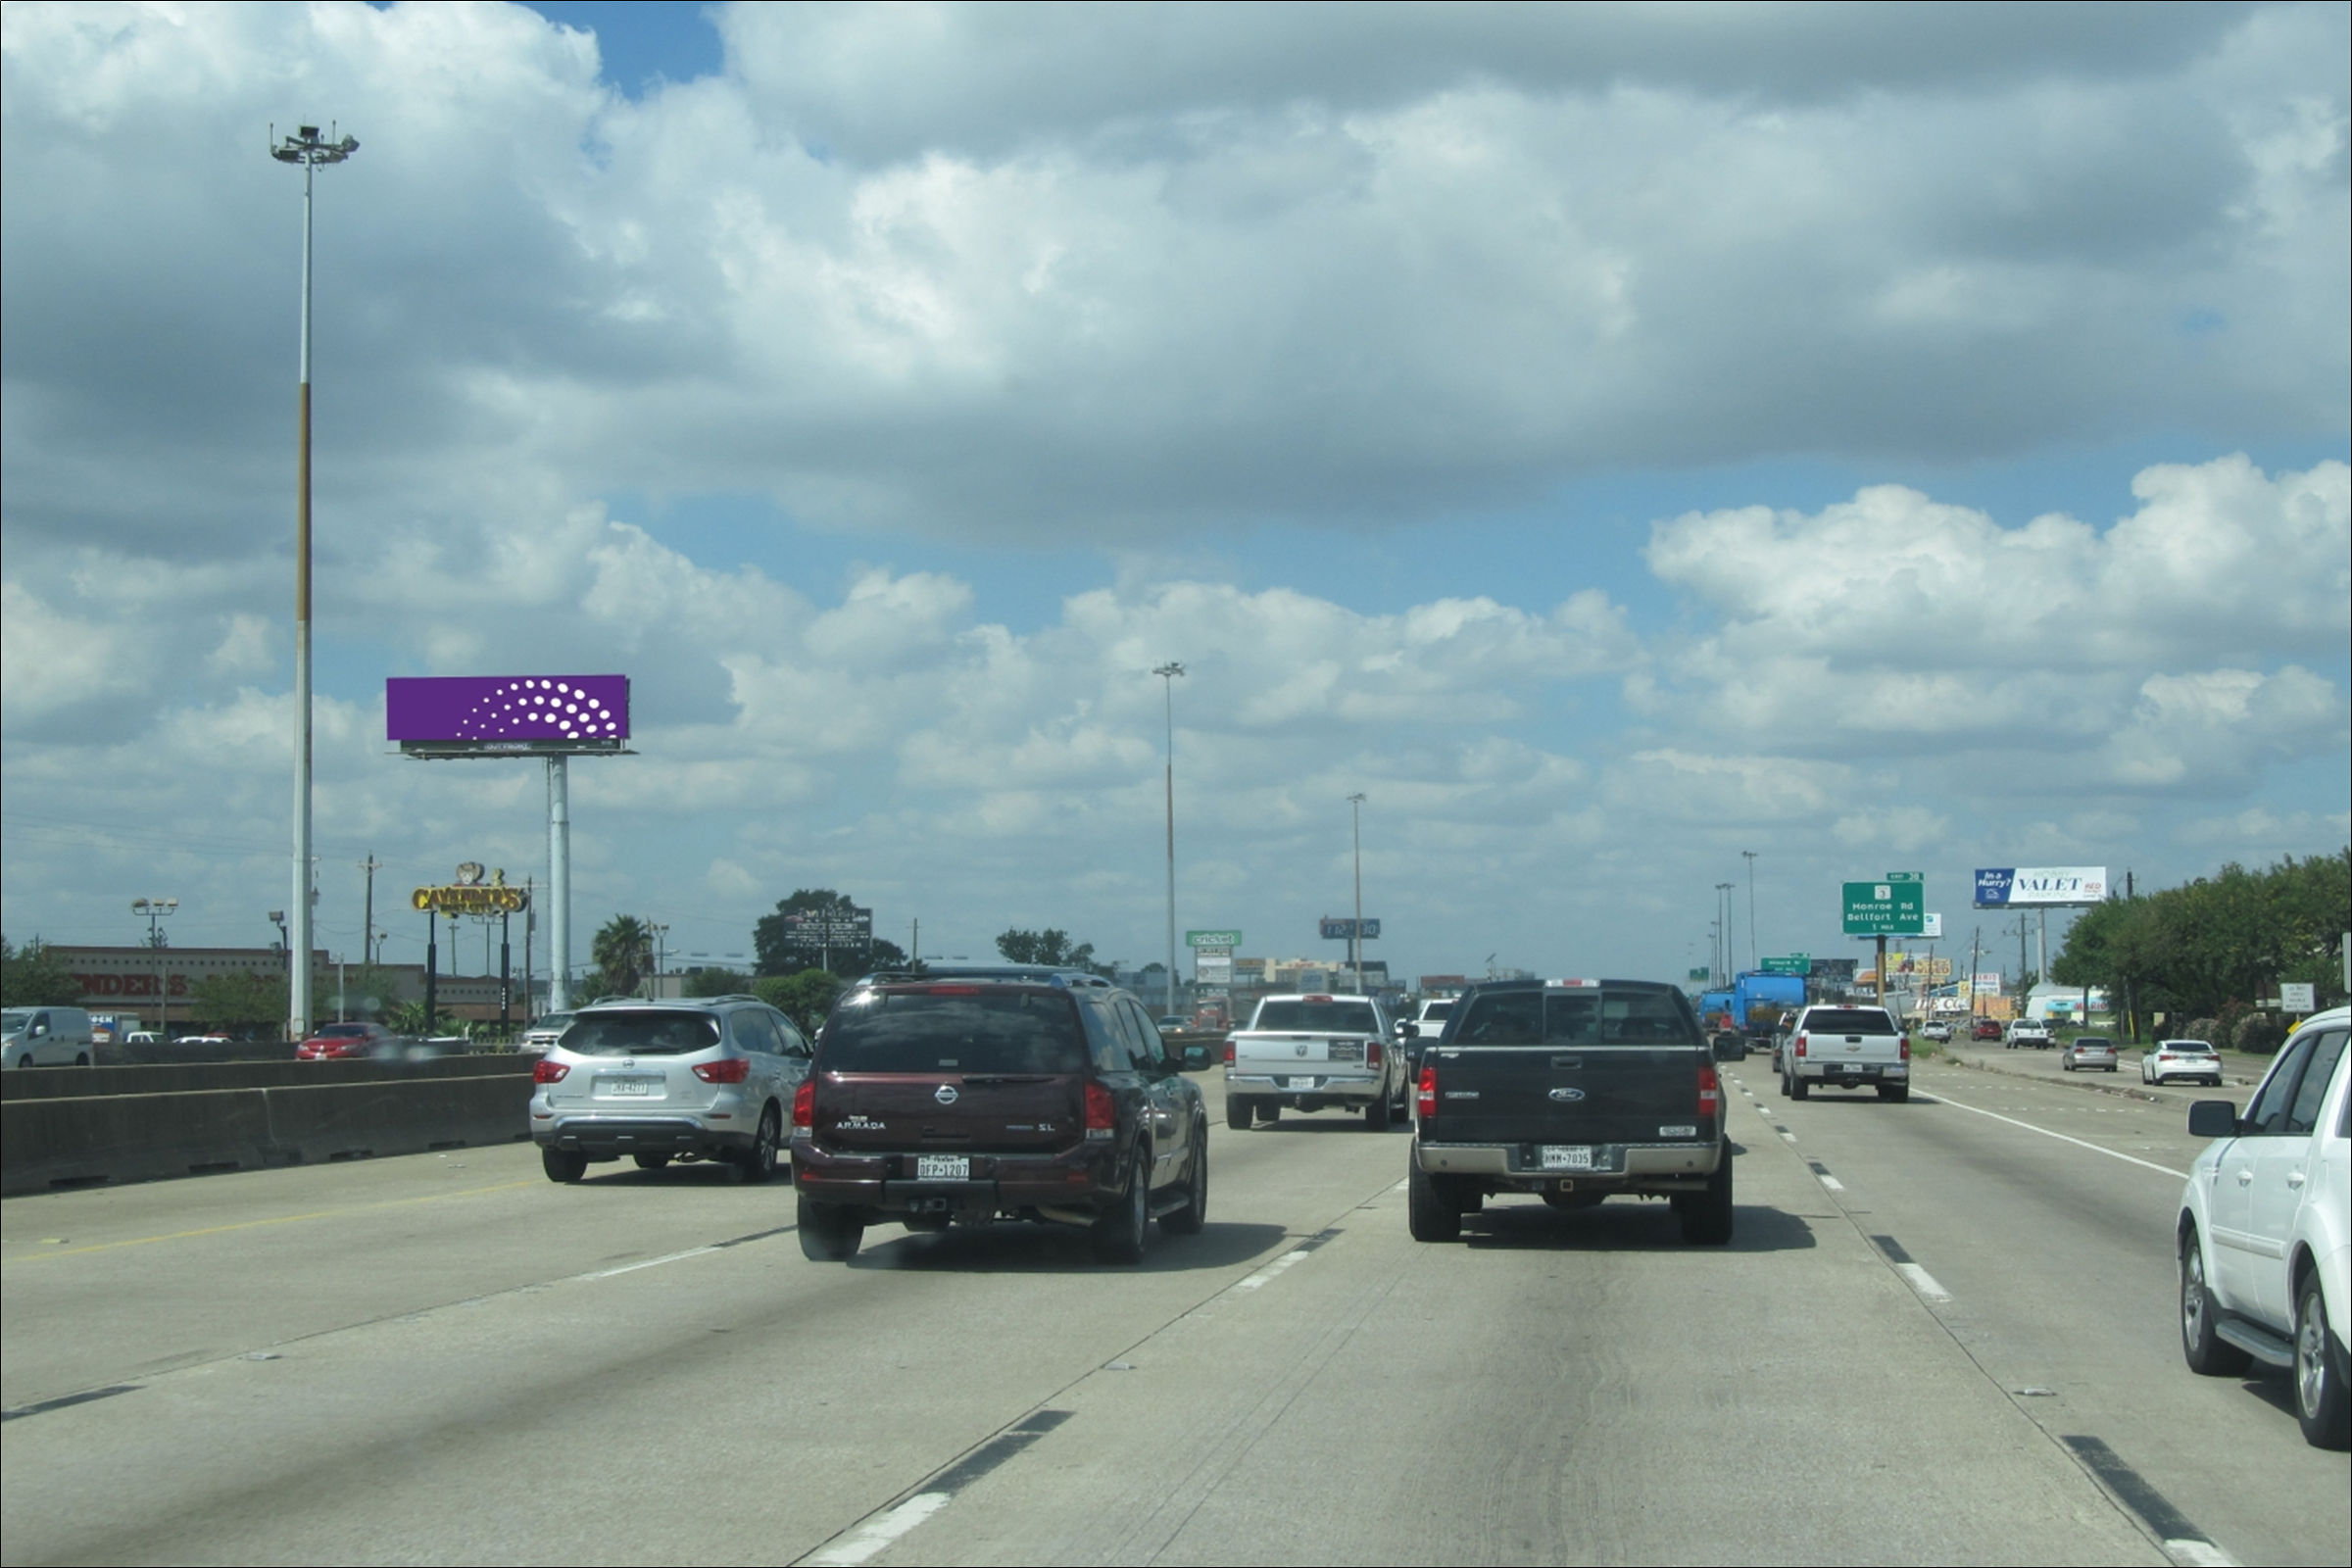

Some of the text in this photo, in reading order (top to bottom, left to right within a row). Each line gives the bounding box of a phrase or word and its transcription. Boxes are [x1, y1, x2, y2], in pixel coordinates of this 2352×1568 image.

[2034, 870, 2071, 879] HOBBY
[1978, 879, 2012, 888] Hurry?
[2019, 878, 2082, 891] VALET
[1880, 890, 1886, 899] 3
[1194, 934, 1234, 944] cricket
